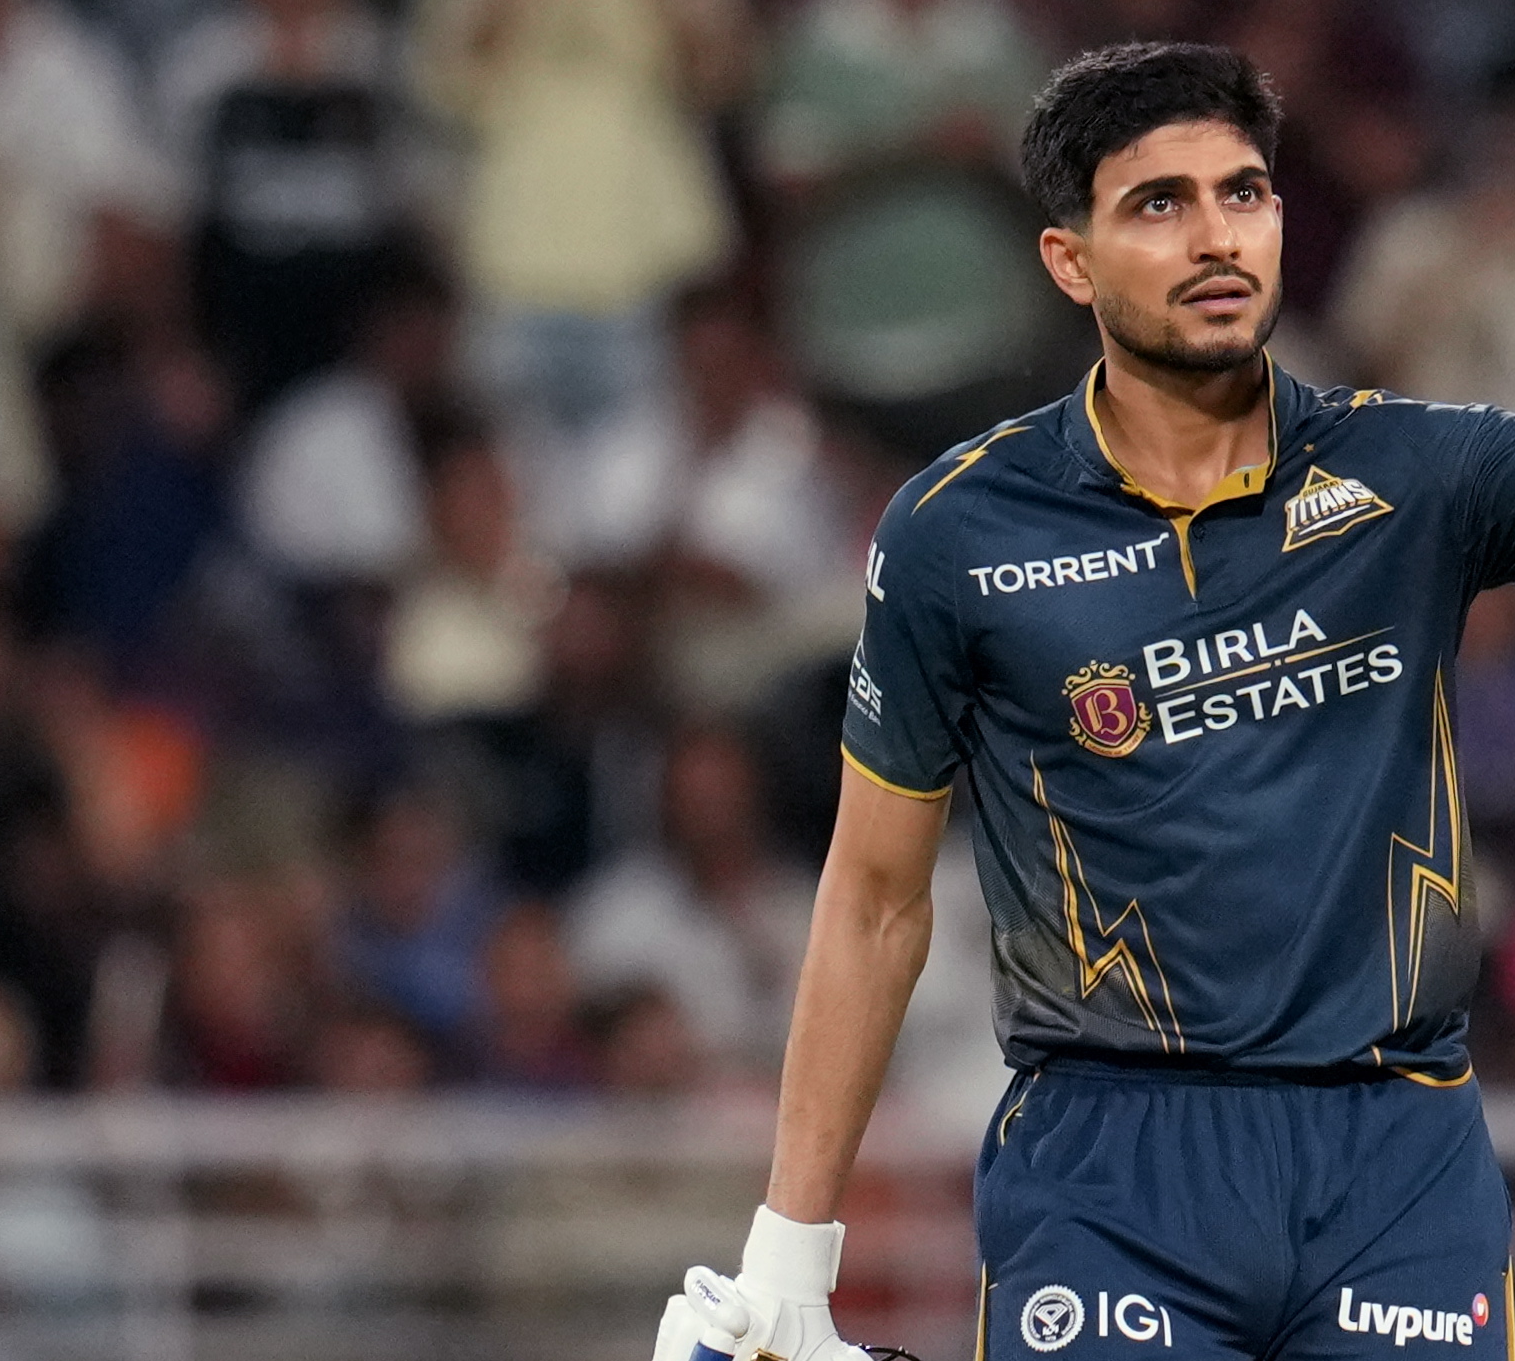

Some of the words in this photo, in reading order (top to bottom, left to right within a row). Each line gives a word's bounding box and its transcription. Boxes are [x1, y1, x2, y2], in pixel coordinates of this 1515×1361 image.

[1288, 480, 1375, 529] TITANS
[968, 532, 1169, 596] TORRENT
[1142, 608, 1327, 689] BIRLA
[1156, 644, 1404, 745] ESTATES
[1338, 1287, 1473, 1346] Livpure
